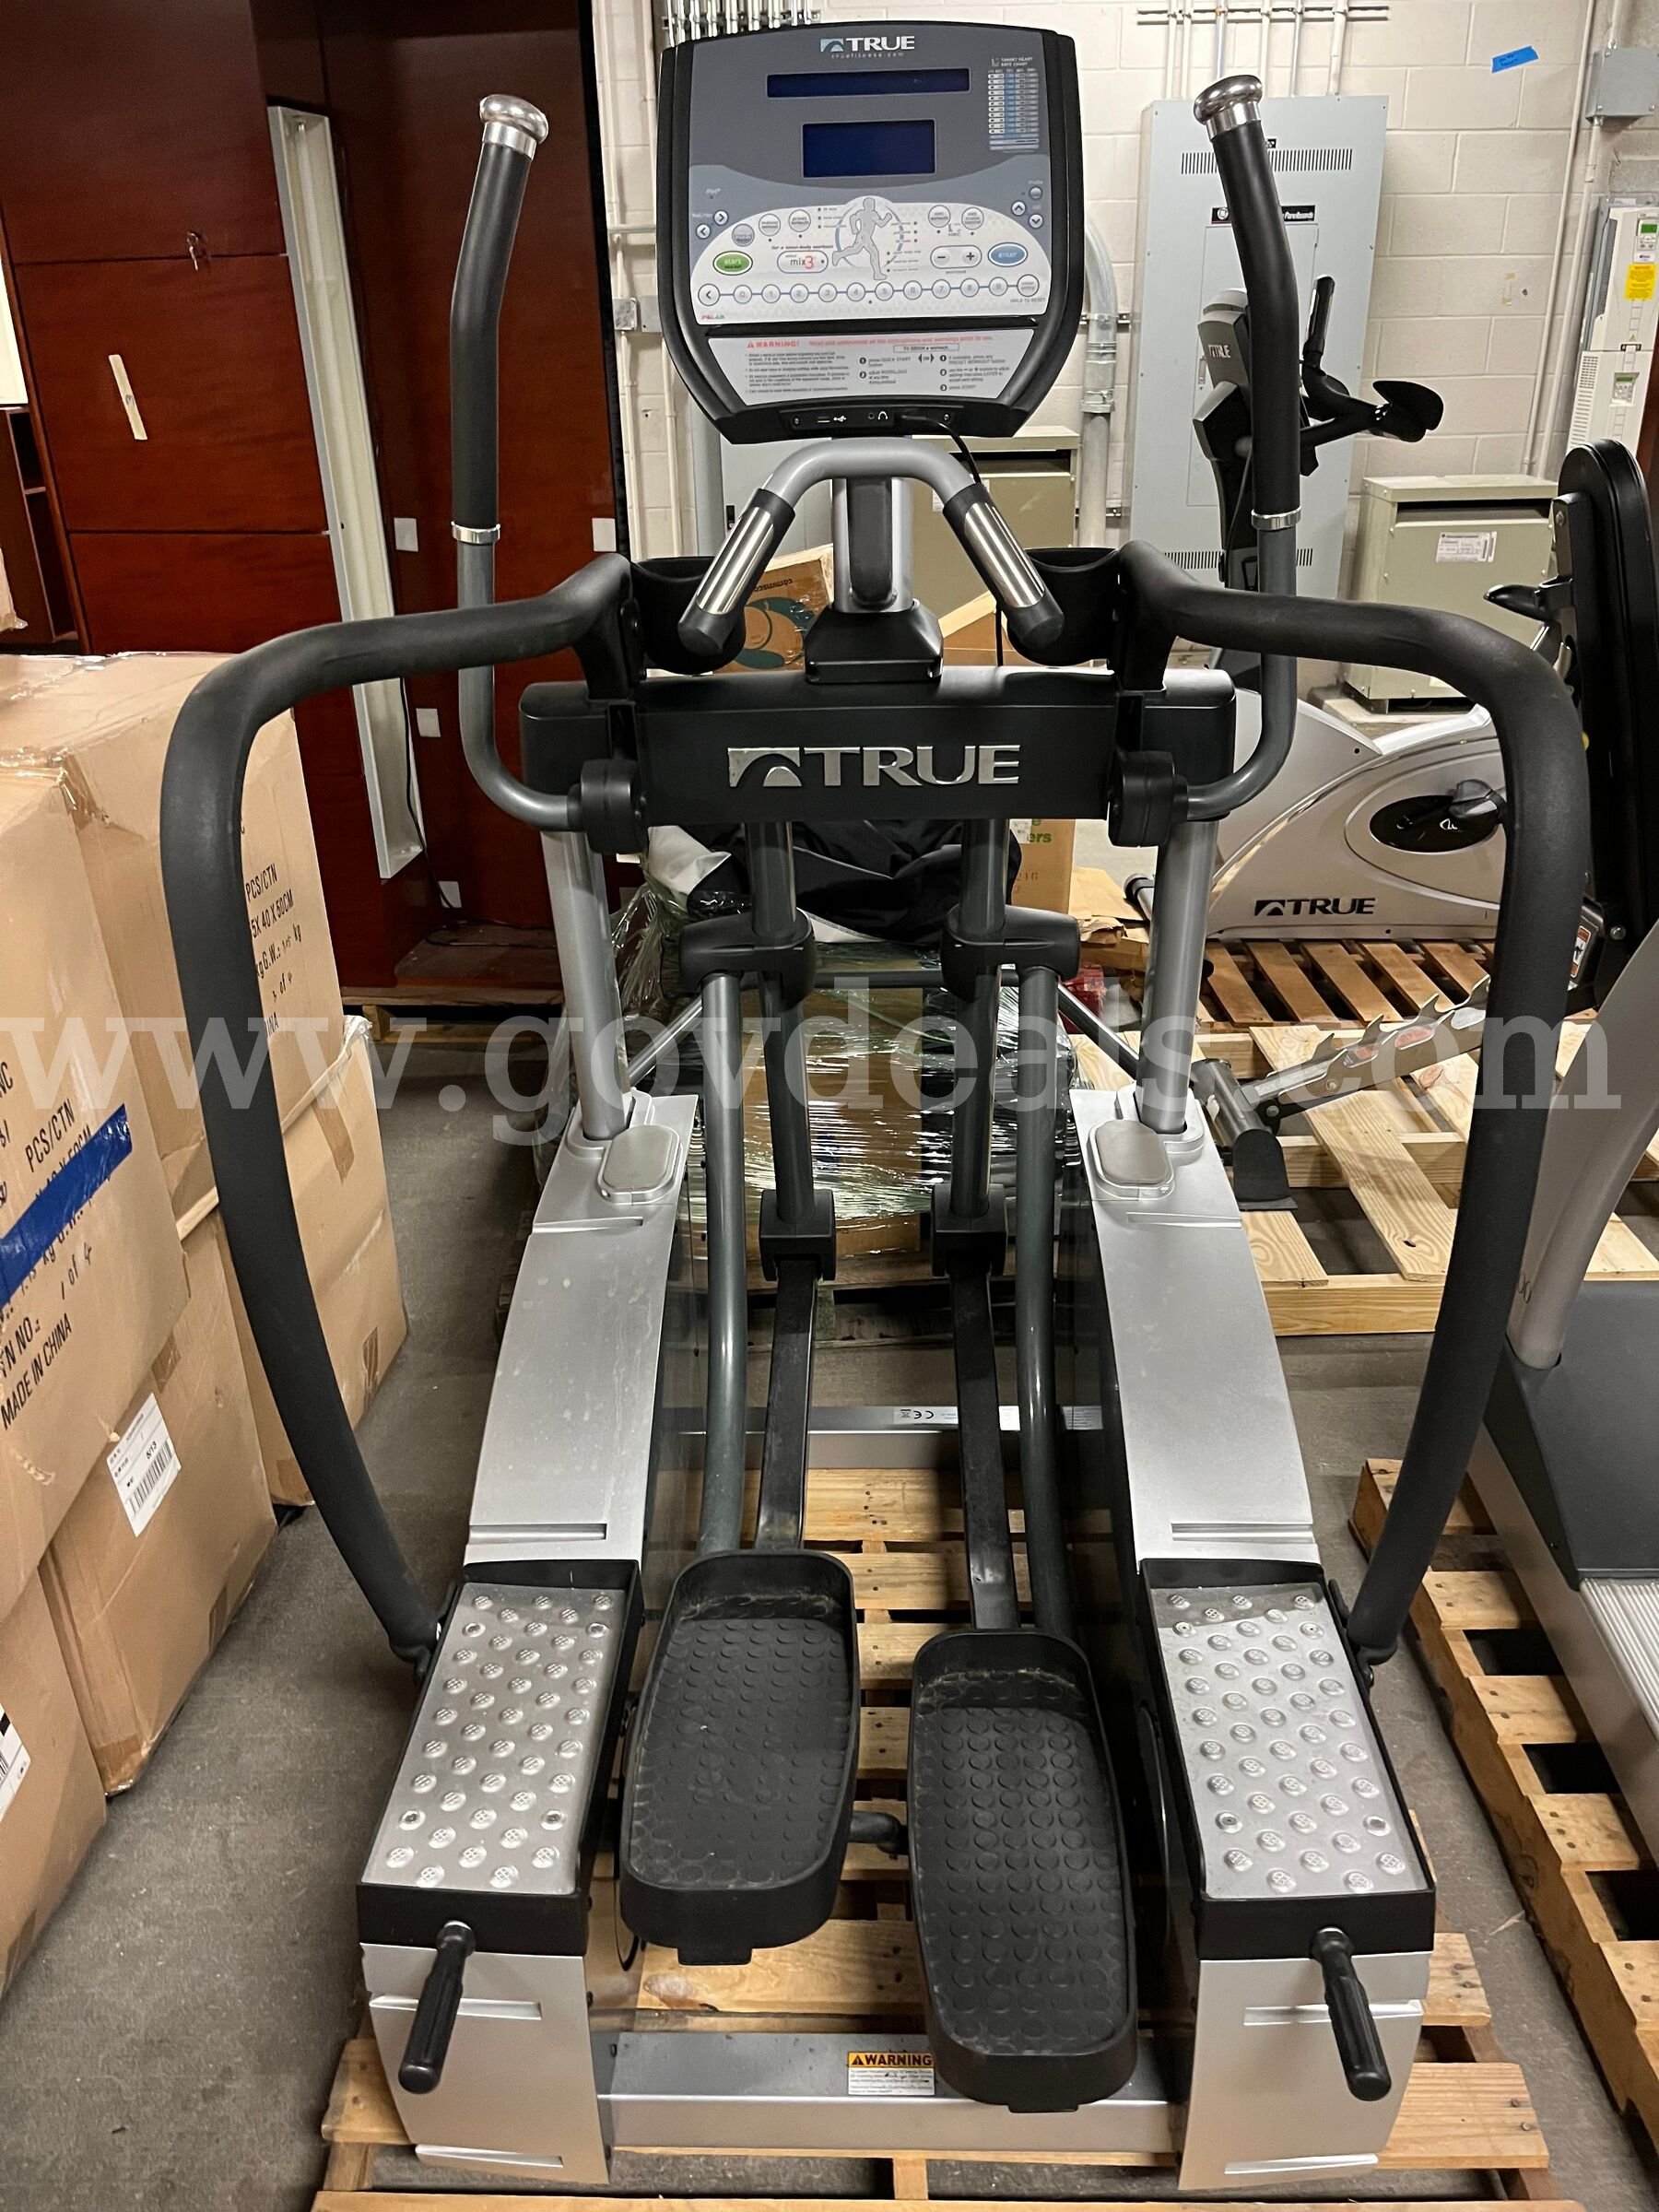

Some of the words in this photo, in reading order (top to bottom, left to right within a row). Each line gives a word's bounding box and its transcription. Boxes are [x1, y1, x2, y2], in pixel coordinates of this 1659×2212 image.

[845, 35, 915, 52] TRUE
[804, 745, 1020, 787] TRUE
[245, 864, 278, 903] PCS/CTN
[262, 910, 270, 930] 40
[276, 888, 294, 919] 50CM
[1285, 897, 1376, 915] TRUE
[25, 1098, 76, 1173] PCS/CTN
[68, 1254, 78, 1286] of
[0, 1369, 33, 1430] MADE
[31, 1357, 44, 1386] IN
[42, 1312, 73, 1368] CHINA
[865, 2054, 933, 2066] WARNING
